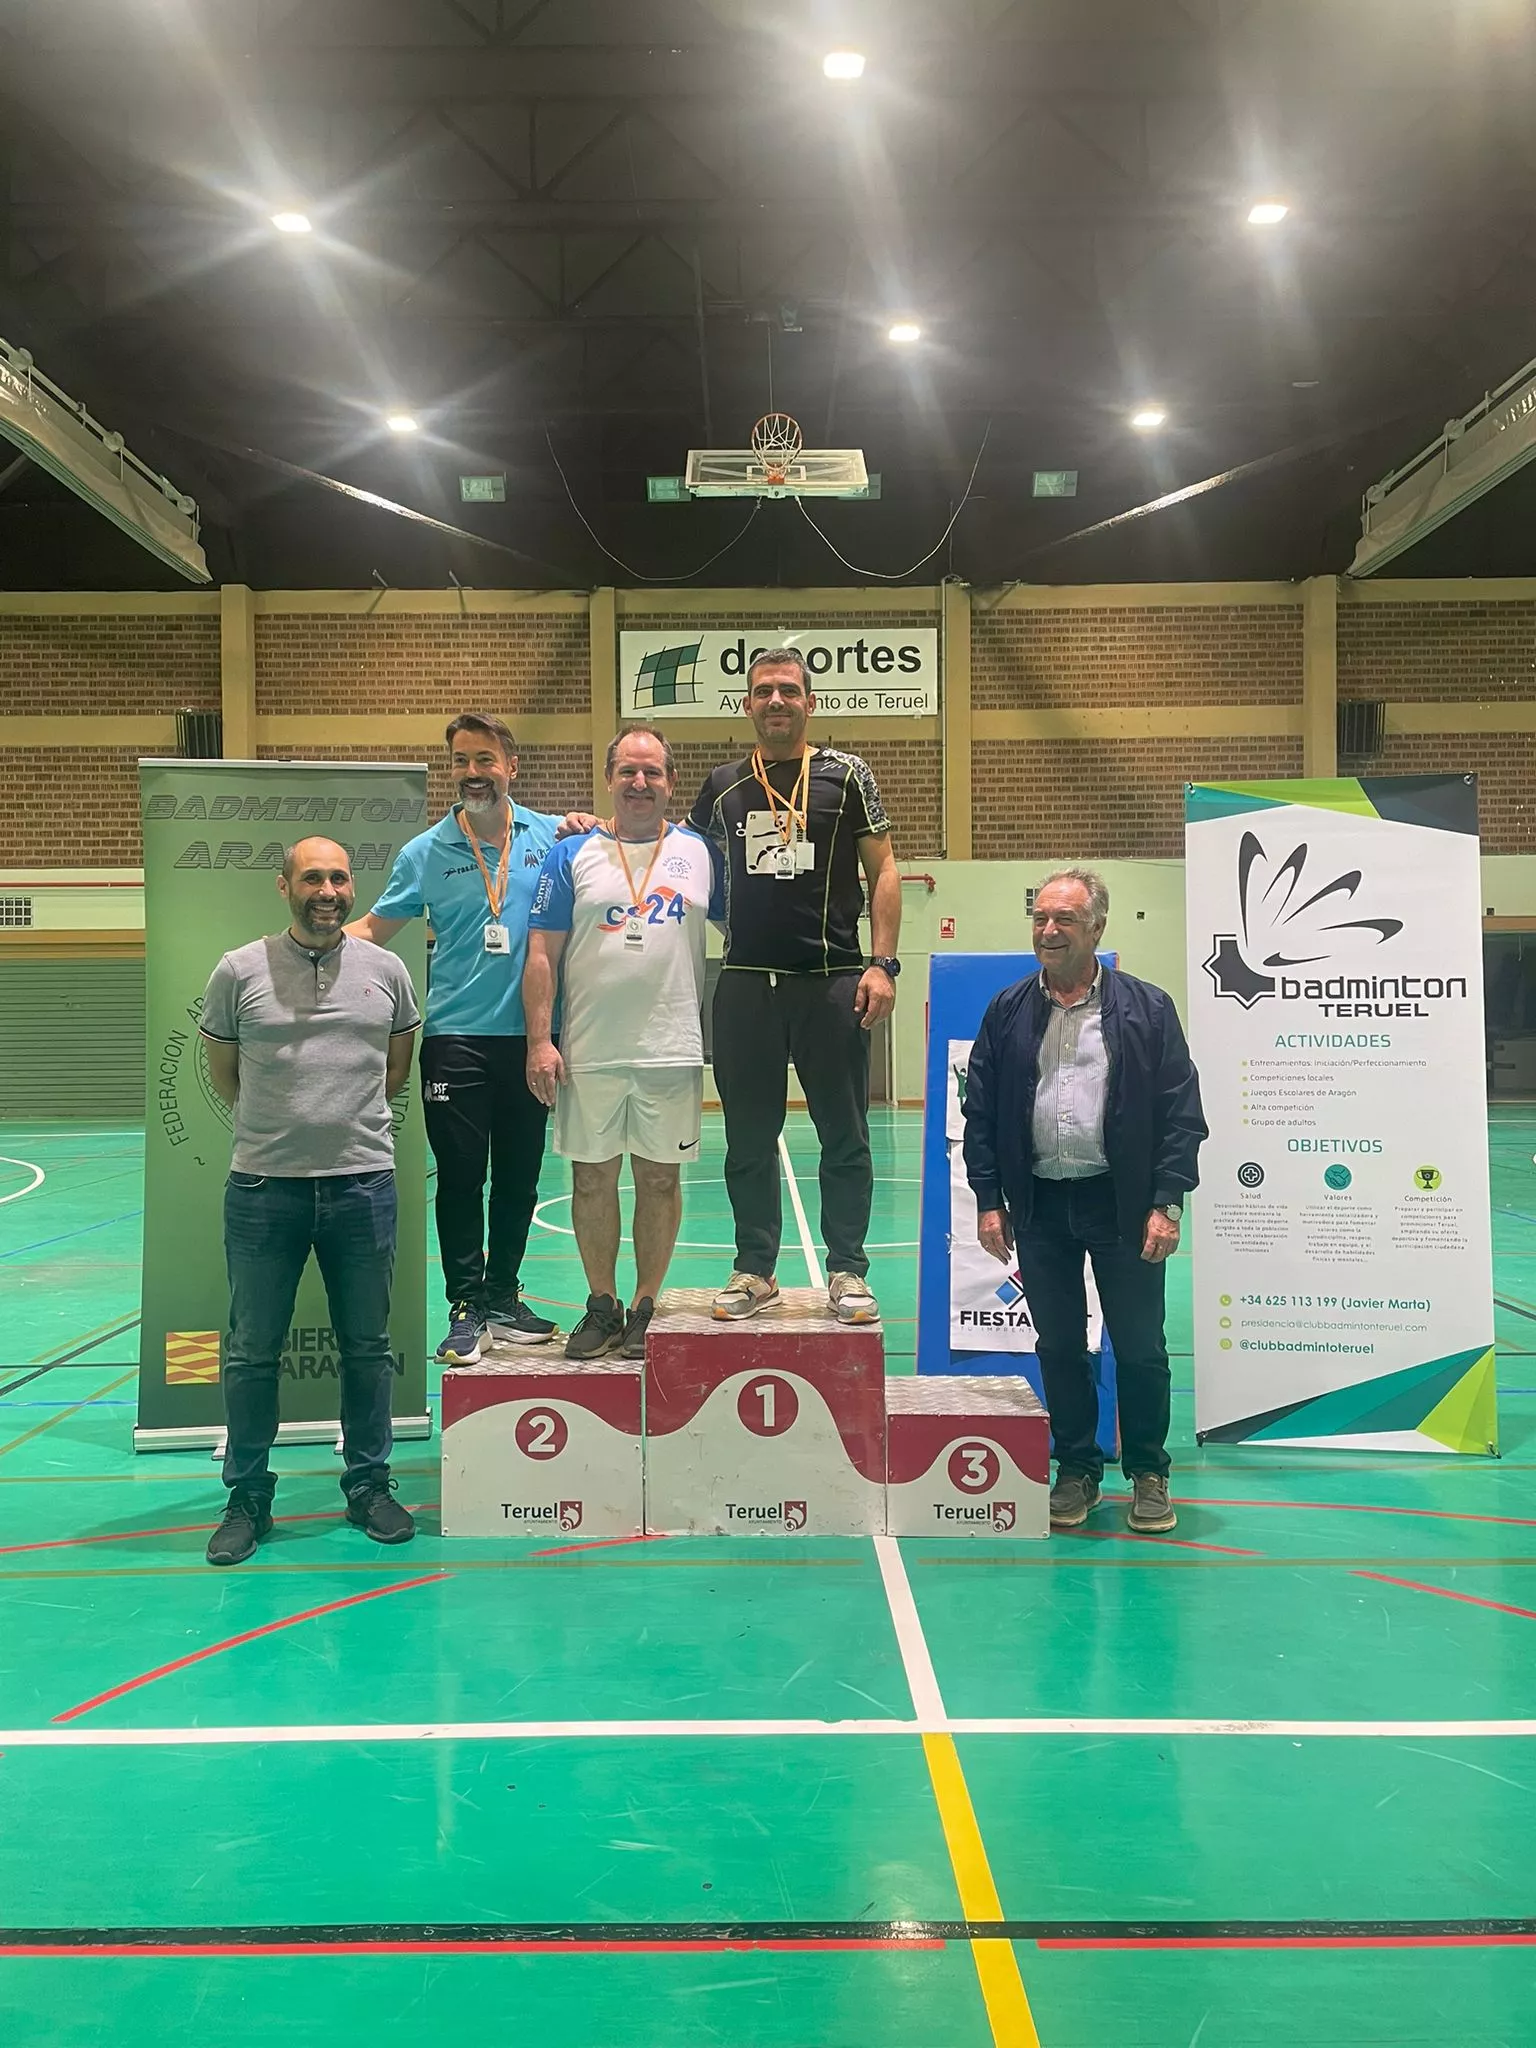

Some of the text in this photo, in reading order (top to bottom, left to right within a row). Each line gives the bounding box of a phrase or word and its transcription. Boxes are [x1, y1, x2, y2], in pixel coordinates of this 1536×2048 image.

[720, 638, 922, 675] dortes
[847, 694, 869, 709] de
[875, 692, 929, 709] Teruel
[145, 795, 425, 823] BADMINTON
[173, 841, 393, 870] ARAN
[1281, 976, 1467, 999] badminton
[1318, 1003, 1430, 1018] TERUEL
[1274, 1034, 1392, 1048] ACTIVIDADES
[1250, 1059, 1313, 1067] Entrenamientos:
[1250, 1074, 1335, 1082] Competiciones locales
[1250, 1089, 1357, 1098] Juegos Escolares de Aragón
[1251, 1103, 1315, 1112] Alta competición
[1251, 1119, 1275, 1127] Grupo
[1287, 1138, 1383, 1153] OBJETIVOS
[1240, 1295, 1431, 1312] +34 625 113 199 (Javier Marta)
[1239, 1340, 1375, 1354] @clubbadmintoteruel
[755, 1384, 776, 1427] 1
[527, 1415, 556, 1453] 2
[960, 1450, 989, 1486] 3
[501, 1502, 558, 1519] Teruel
[725, 1502, 783, 1519] Teruel
[933, 1503, 991, 1520] Teruel
